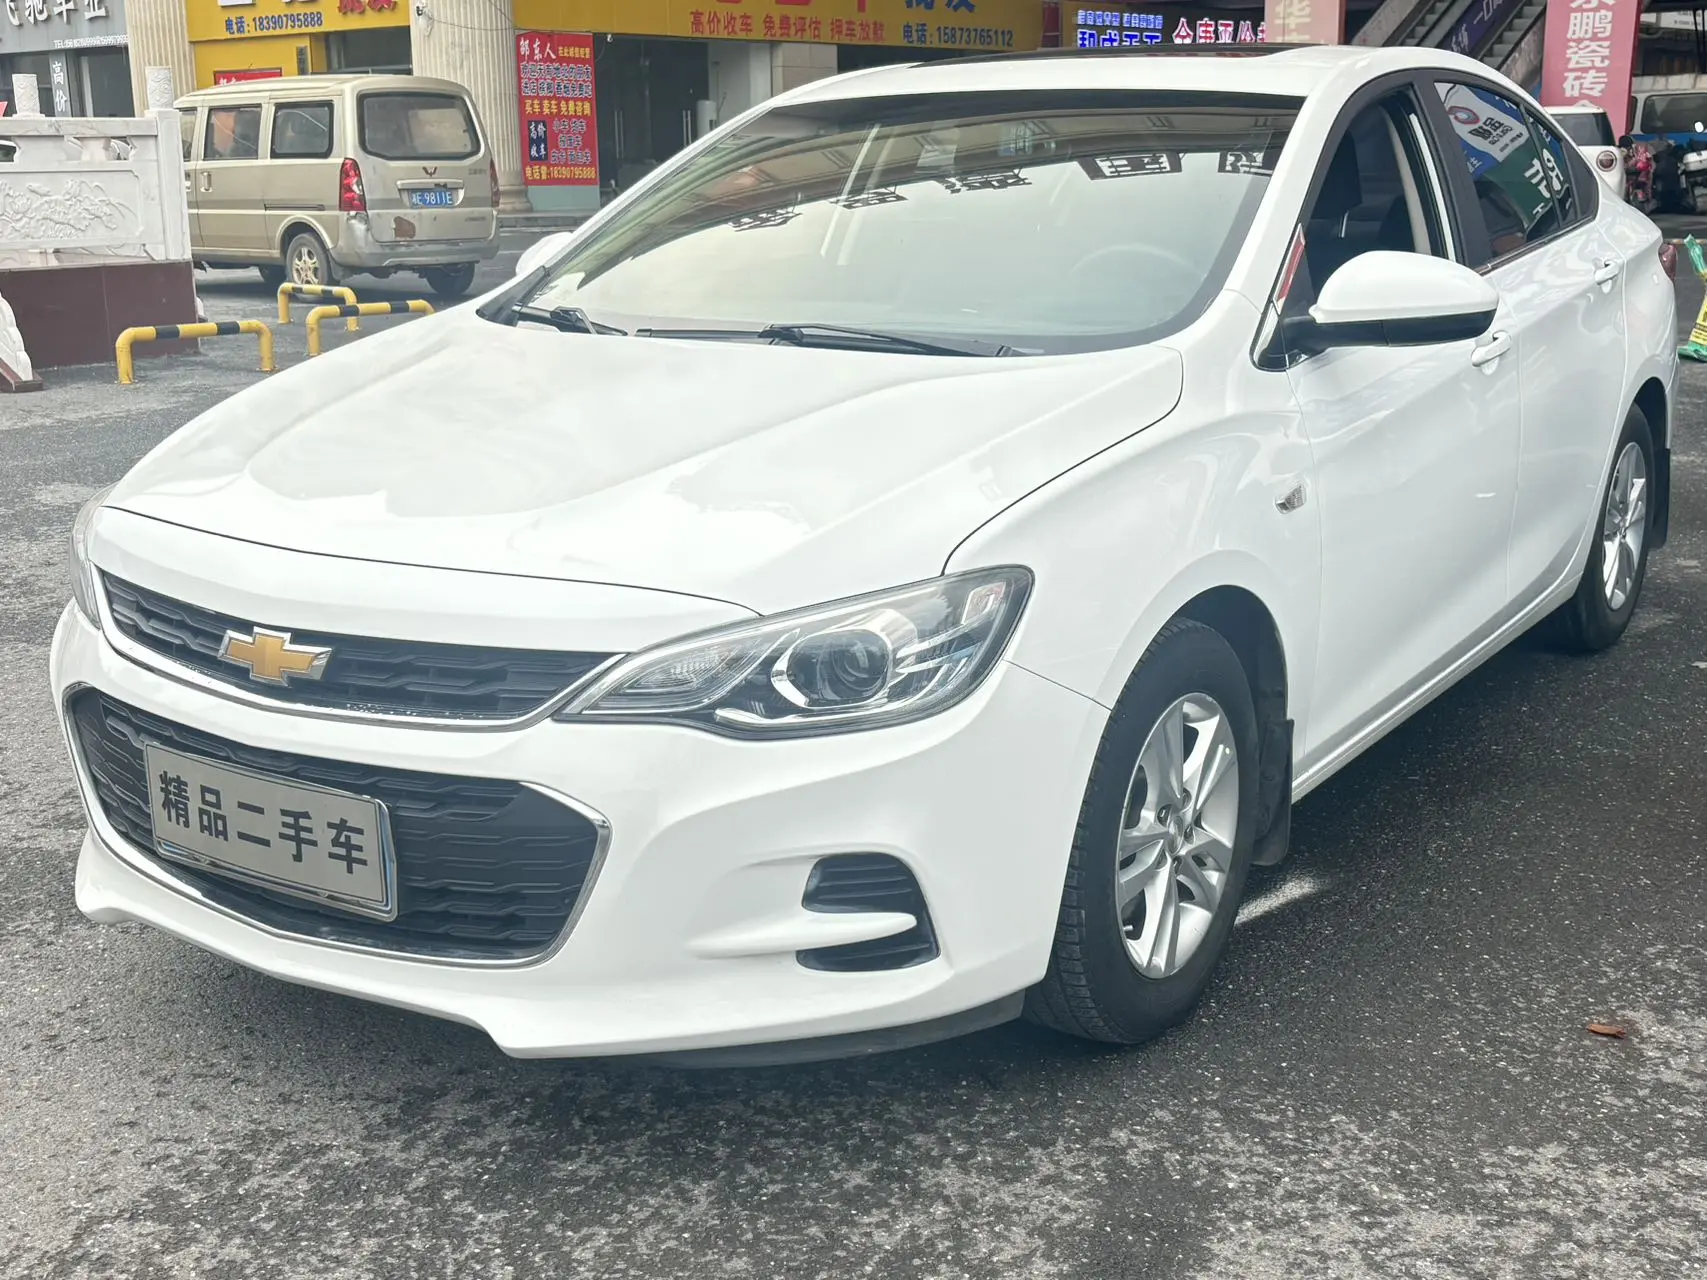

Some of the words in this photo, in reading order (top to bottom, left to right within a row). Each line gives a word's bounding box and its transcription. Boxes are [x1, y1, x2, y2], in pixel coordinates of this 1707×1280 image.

[690, 9, 753, 37] 高价收车
[762, 13, 821, 39] 免费评估
[830, 16, 885, 42] 押车放款
[52, 61, 67, 112] 高价
[525, 98, 540, 114] 买车
[560, 100, 591, 116] 免费咨询
[159, 770, 368, 874] 精品二手车
